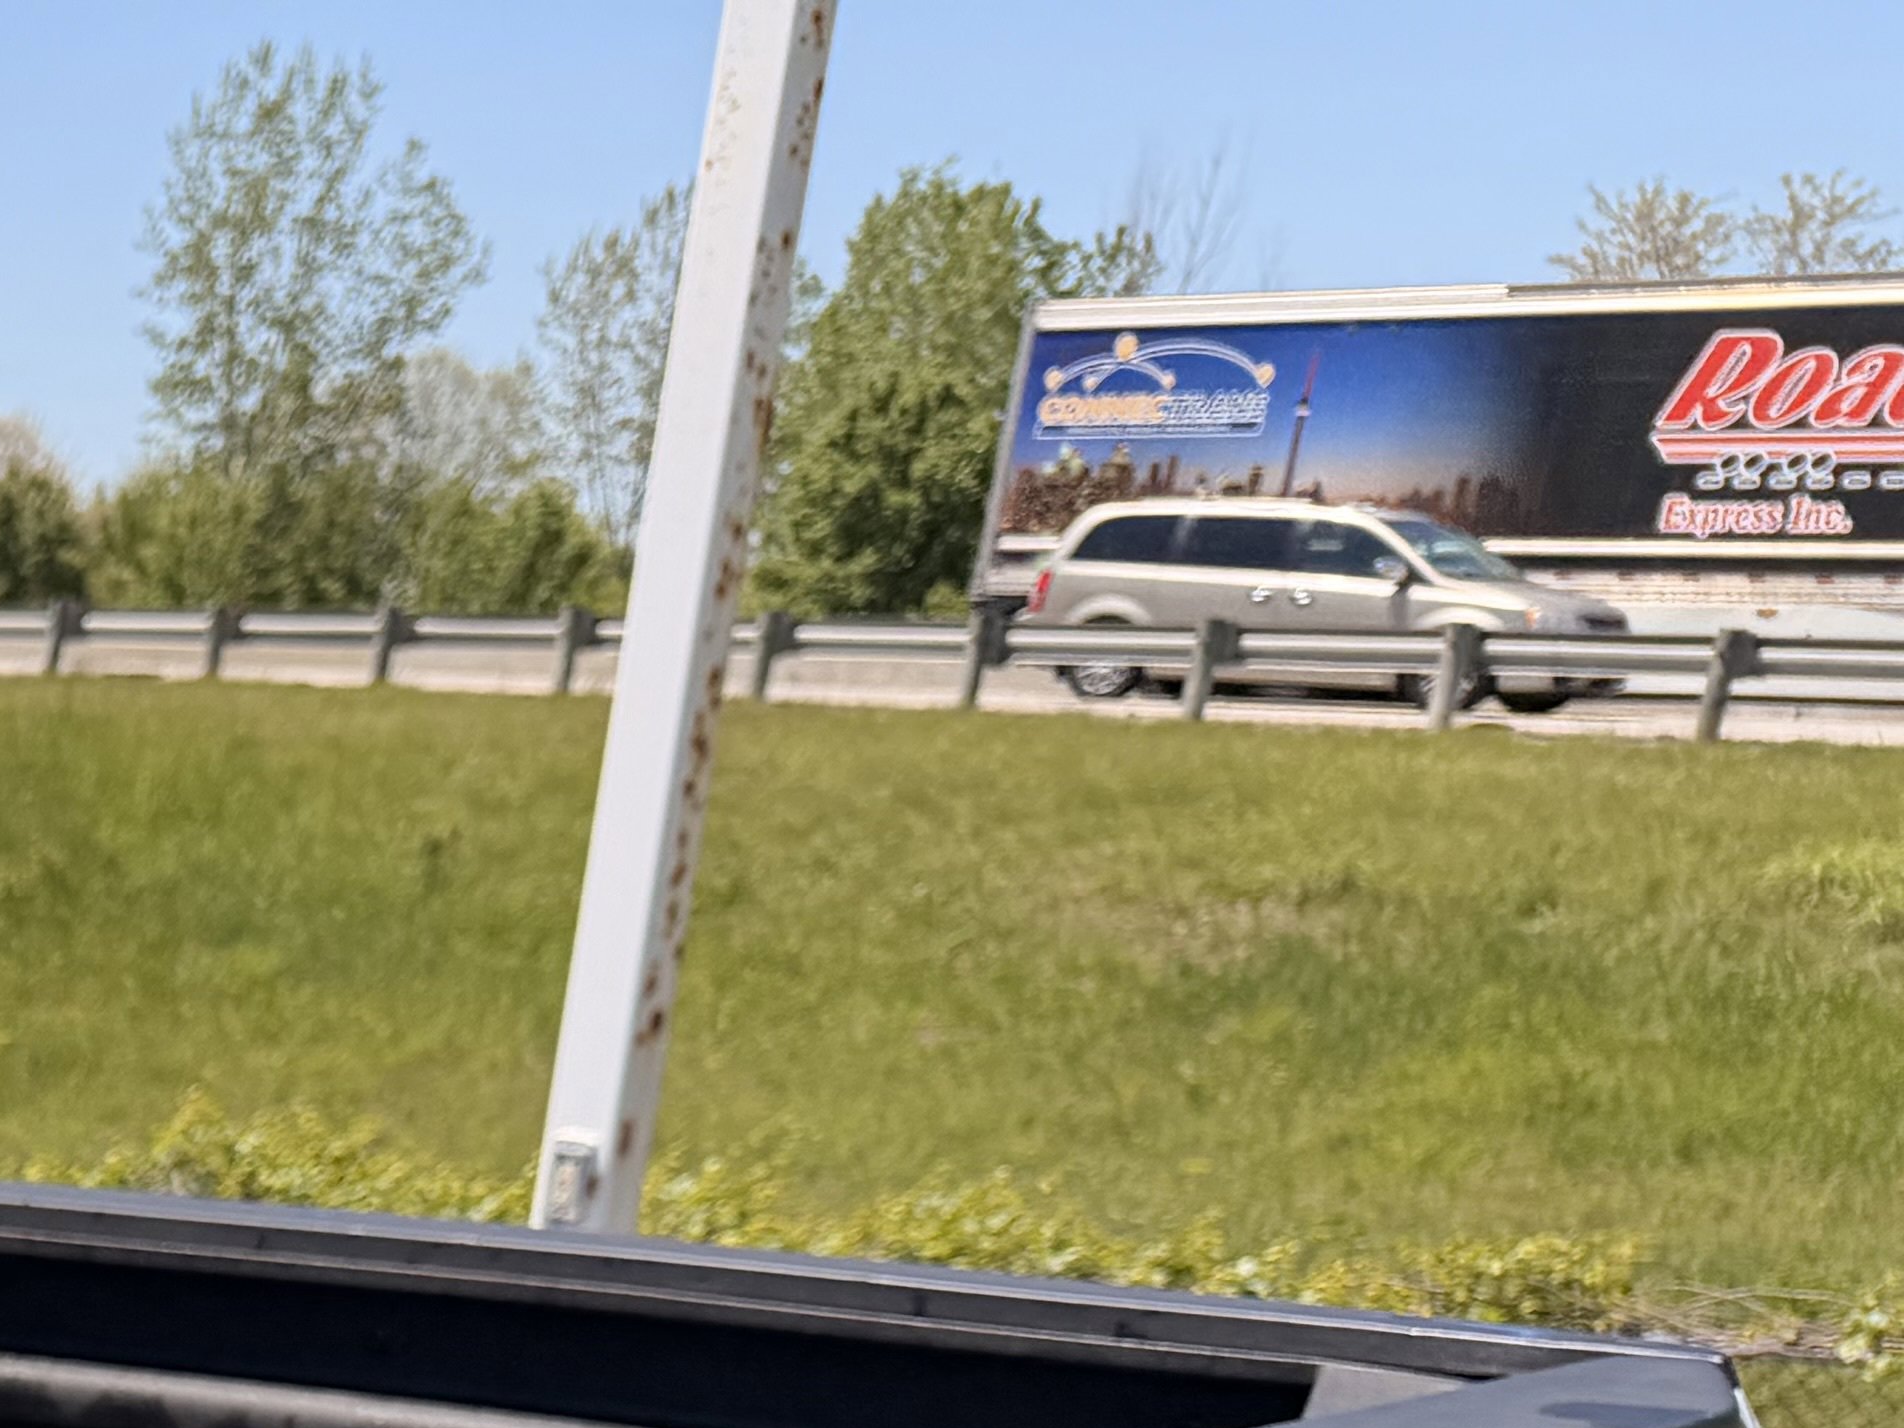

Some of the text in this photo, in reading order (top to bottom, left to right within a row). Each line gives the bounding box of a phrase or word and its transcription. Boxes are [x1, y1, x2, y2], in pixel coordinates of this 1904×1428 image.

[1655, 328, 1904, 431] Roa
[1659, 493, 1853, 538] Express Inc.
